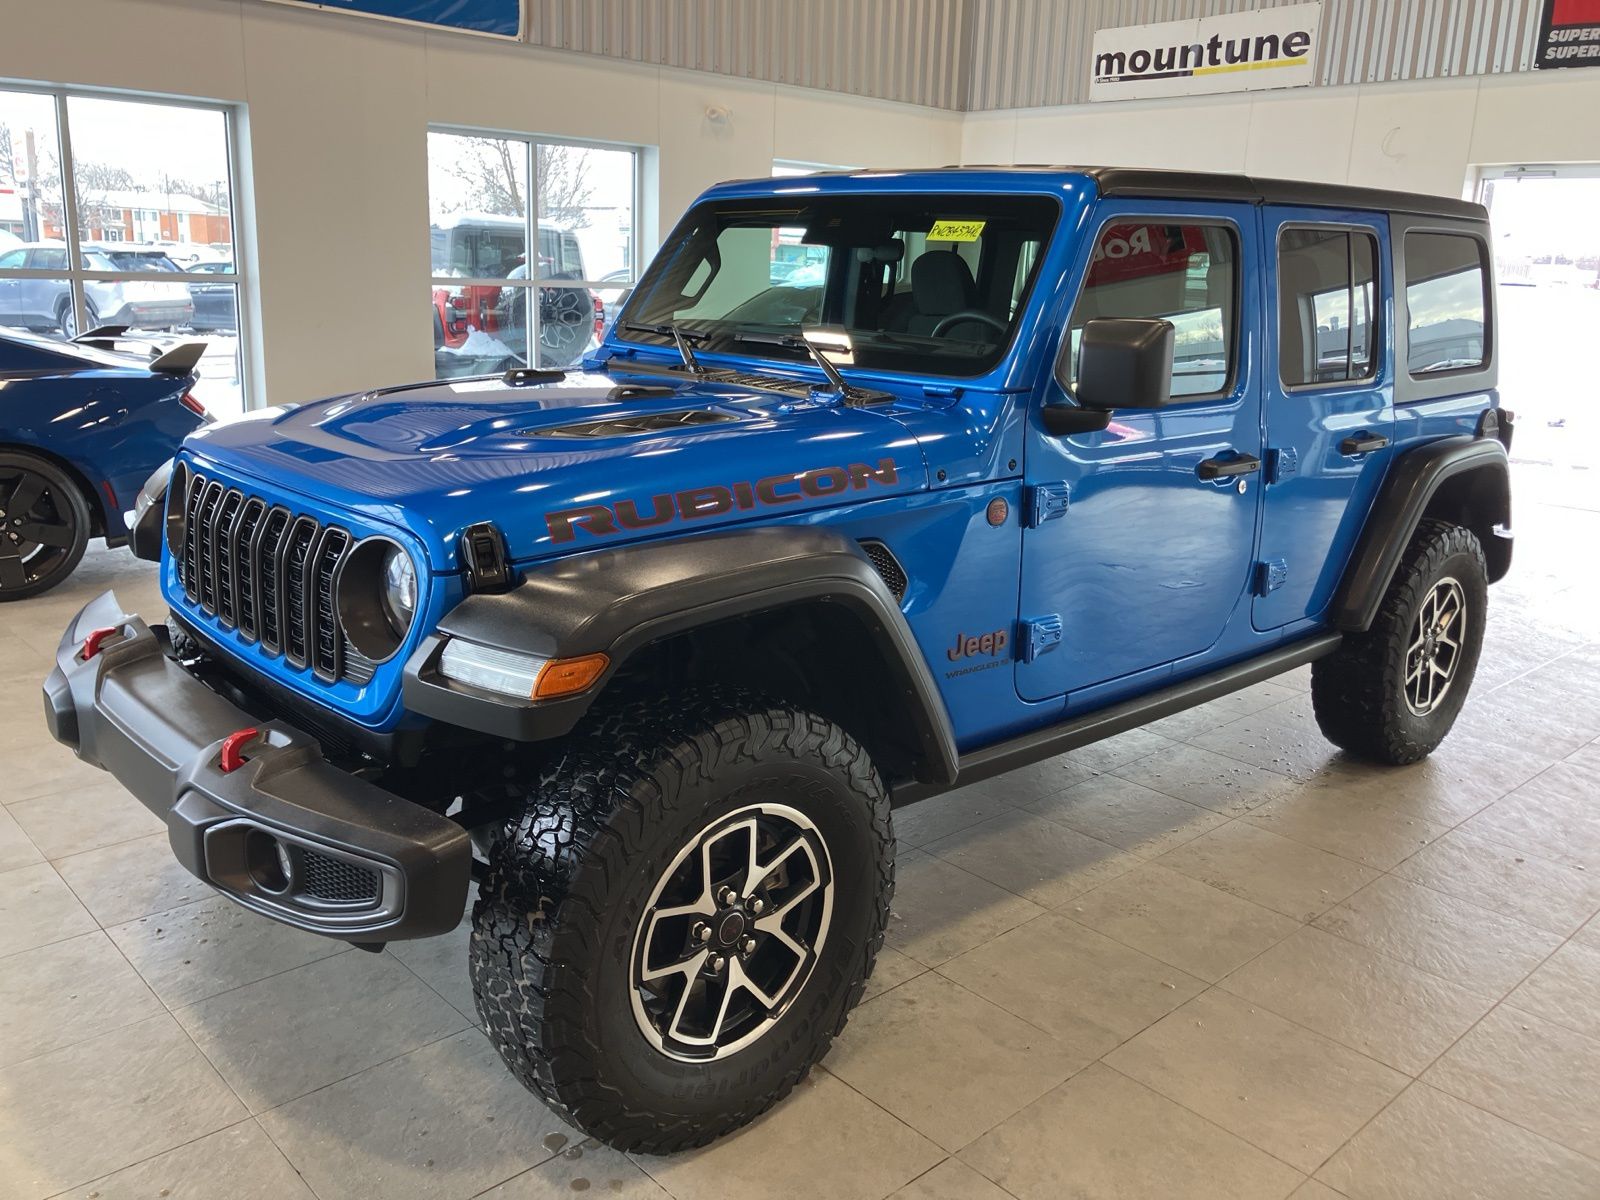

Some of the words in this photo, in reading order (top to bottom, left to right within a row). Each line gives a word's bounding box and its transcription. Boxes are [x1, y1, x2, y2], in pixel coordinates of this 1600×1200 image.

[1095, 31, 1311, 76] mountune
[1544, 45, 1600, 60] SUPER
[544, 457, 898, 545] RUBICON
[947, 629, 1008, 661] Jeep
[945, 661, 999, 679] WRANGLER
